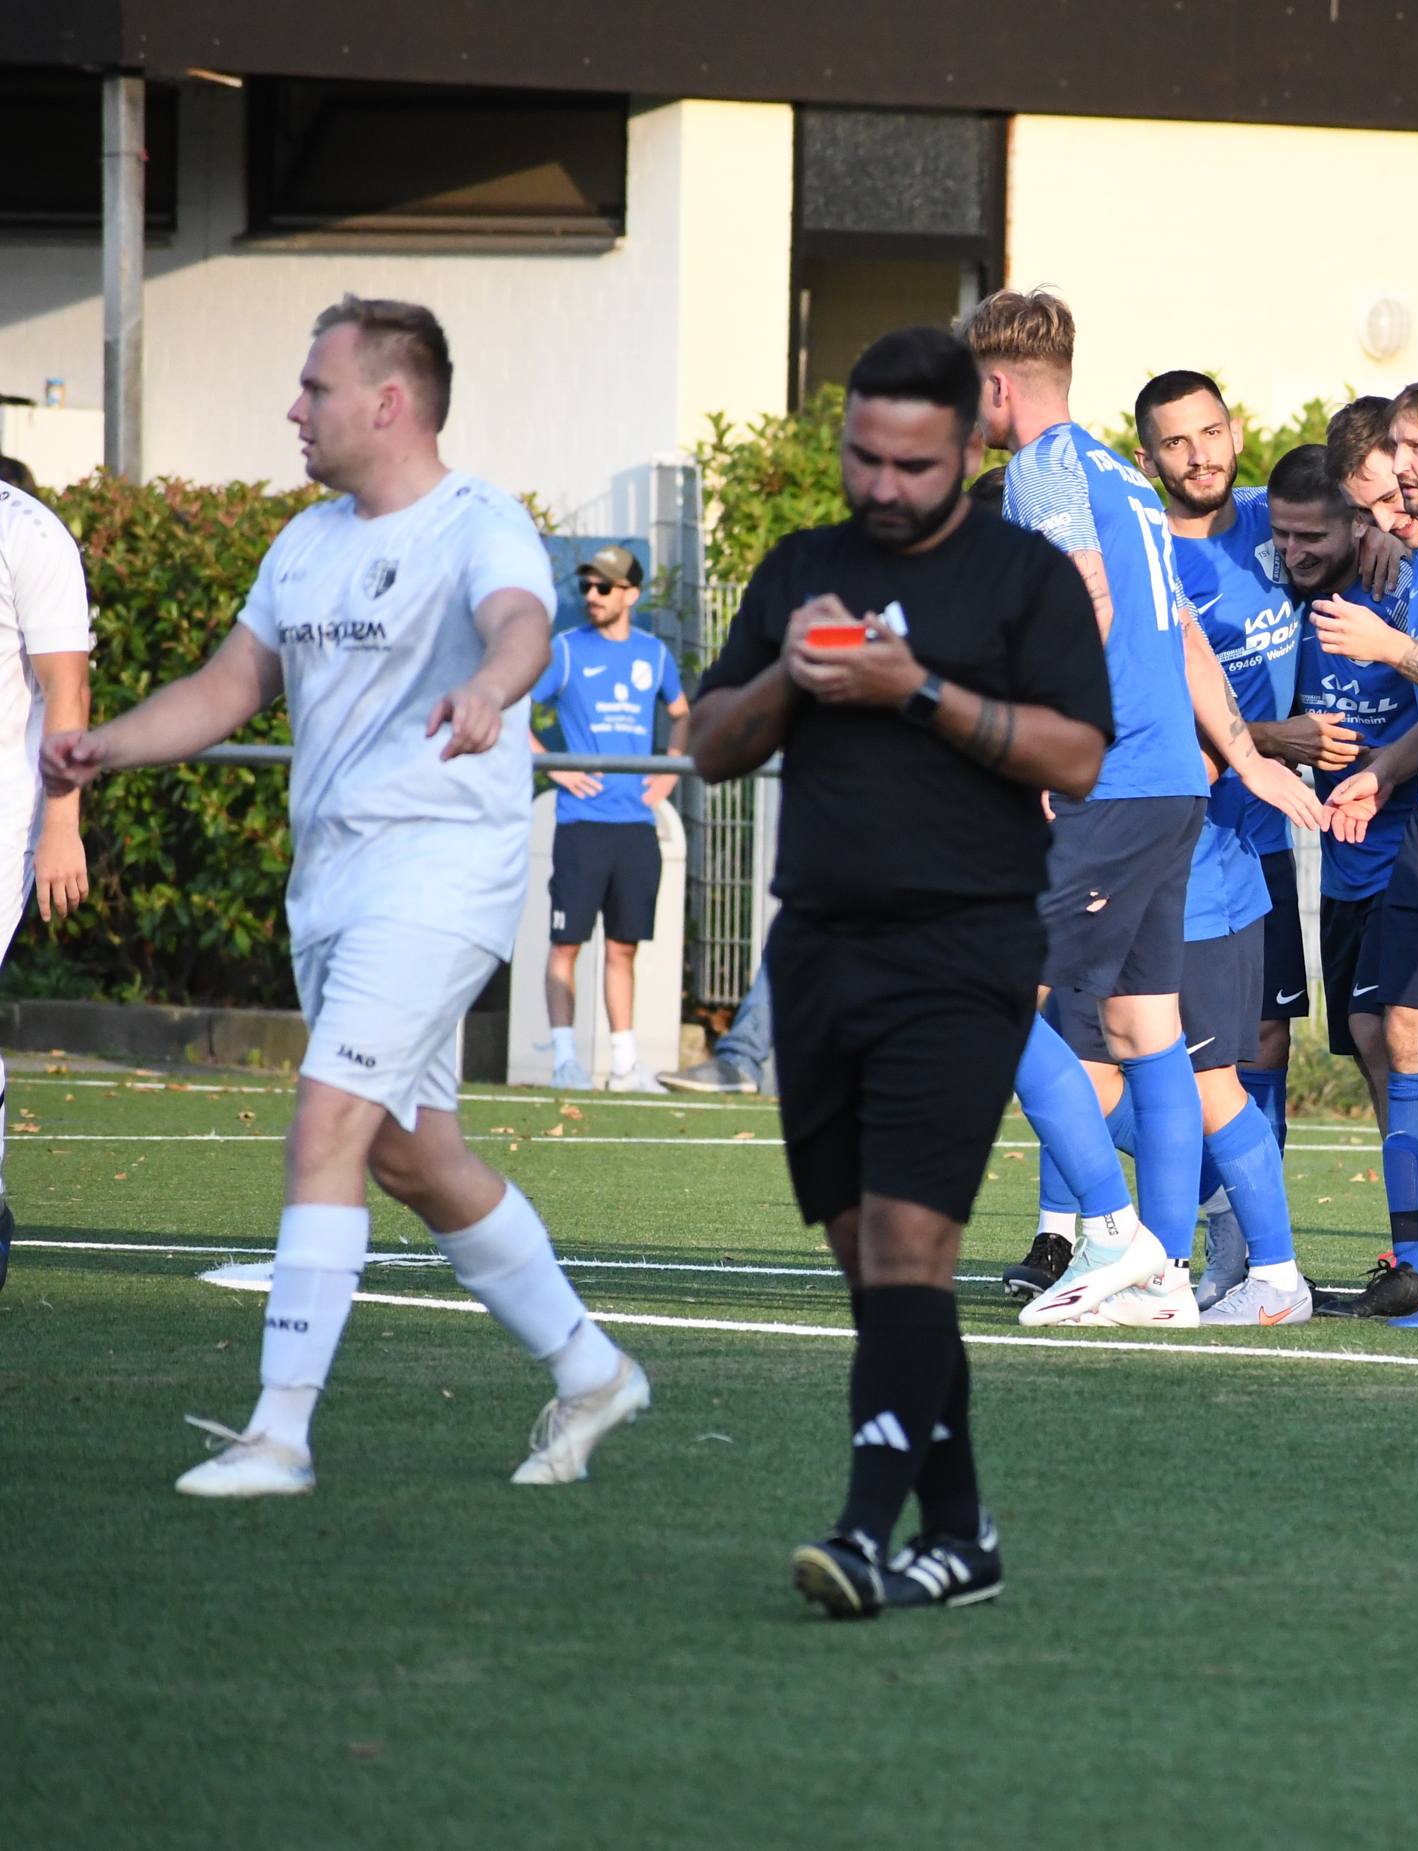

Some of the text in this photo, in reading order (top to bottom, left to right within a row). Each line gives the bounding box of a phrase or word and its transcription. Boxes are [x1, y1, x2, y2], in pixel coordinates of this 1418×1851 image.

[1228, 655, 1263, 672] 69469
[1341, 713, 1387, 725] einheim
[336, 1043, 377, 1070] JAKO
[264, 1317, 309, 1334] AKO
